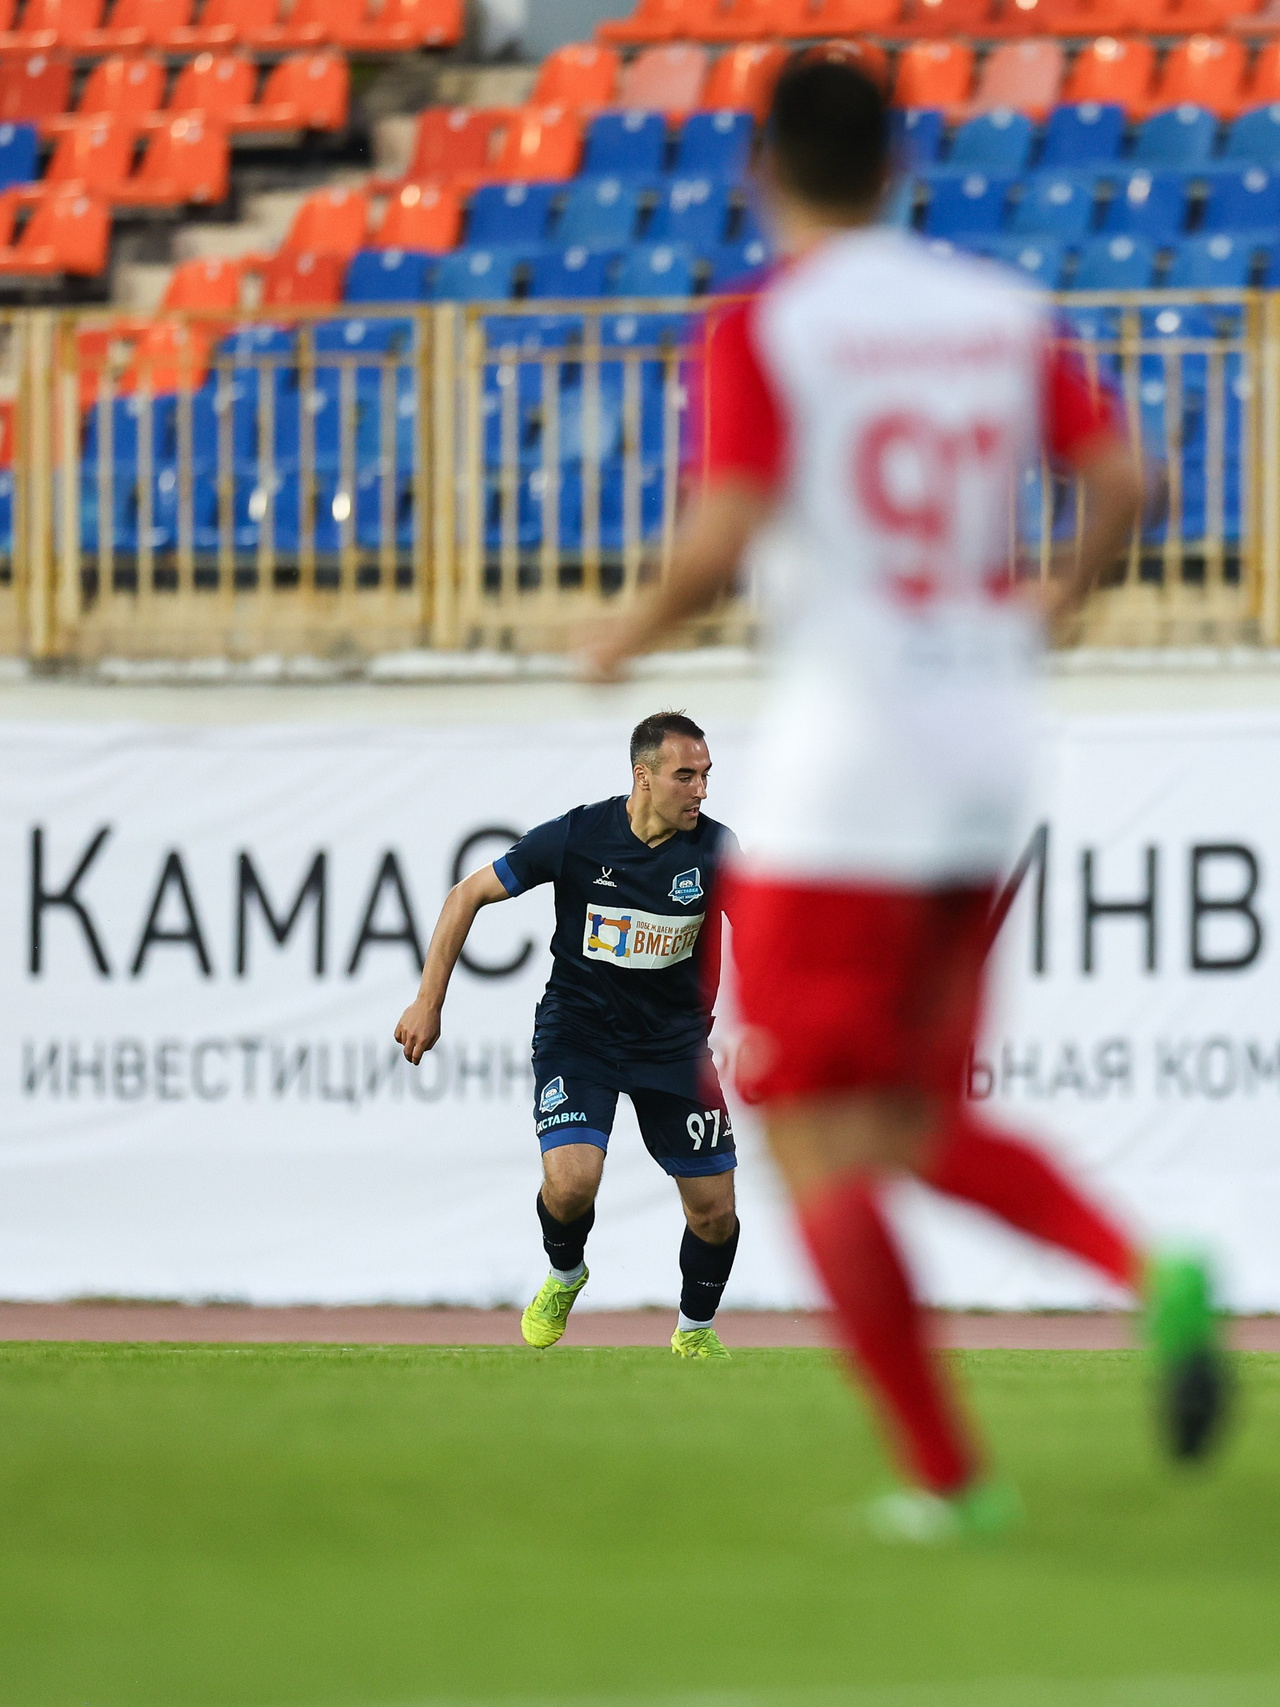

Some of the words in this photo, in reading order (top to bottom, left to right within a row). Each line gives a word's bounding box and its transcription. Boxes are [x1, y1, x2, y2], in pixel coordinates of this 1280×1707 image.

[636, 920, 673, 935] ПОБЕЖДАЕМ
[633, 929, 699, 957] ВМЕСТЕ
[686, 1108, 720, 1151] 97
